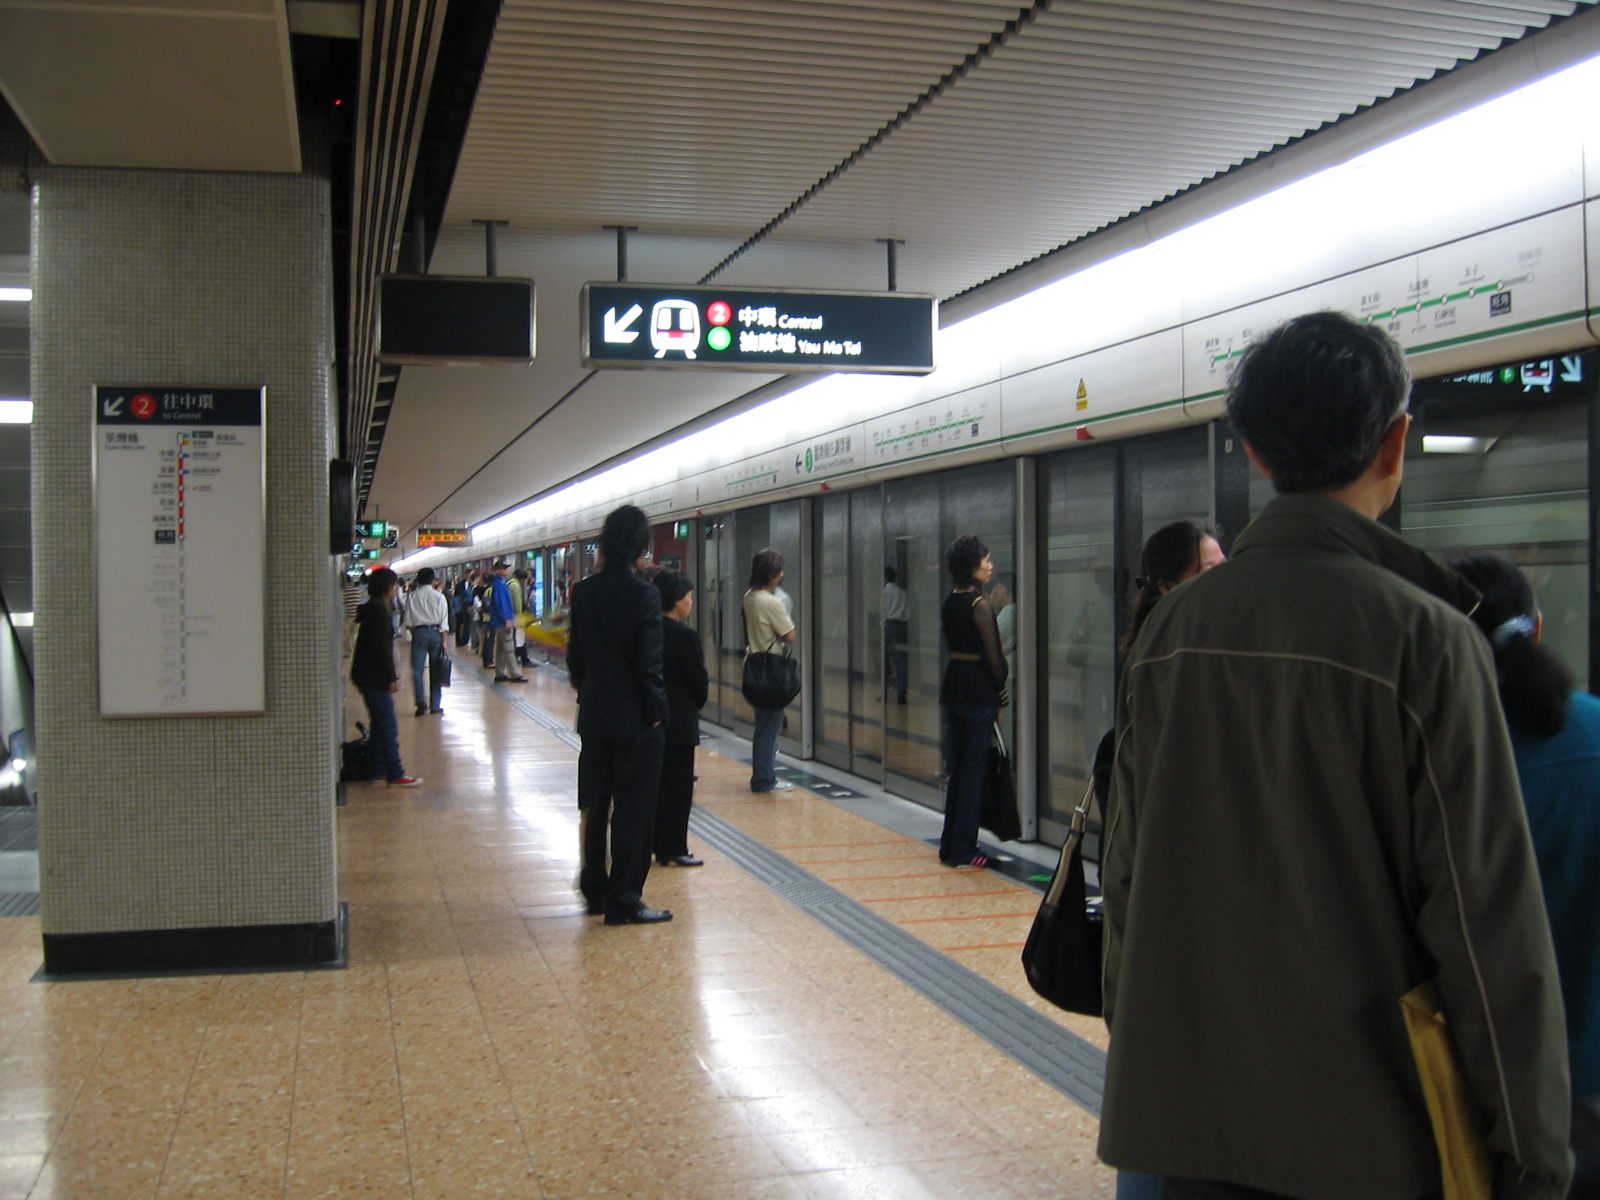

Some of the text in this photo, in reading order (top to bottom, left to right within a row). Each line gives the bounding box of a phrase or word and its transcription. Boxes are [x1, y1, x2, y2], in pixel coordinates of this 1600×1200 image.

[713, 304, 726, 322] 2
[738, 305, 823, 330] 中環 Central
[713, 330, 725, 347] 4
[823, 340, 842, 355] Ma
[138, 398, 149, 415] 2
[163, 393, 214, 410] 往中環
[163, 411, 202, 420] to Central
